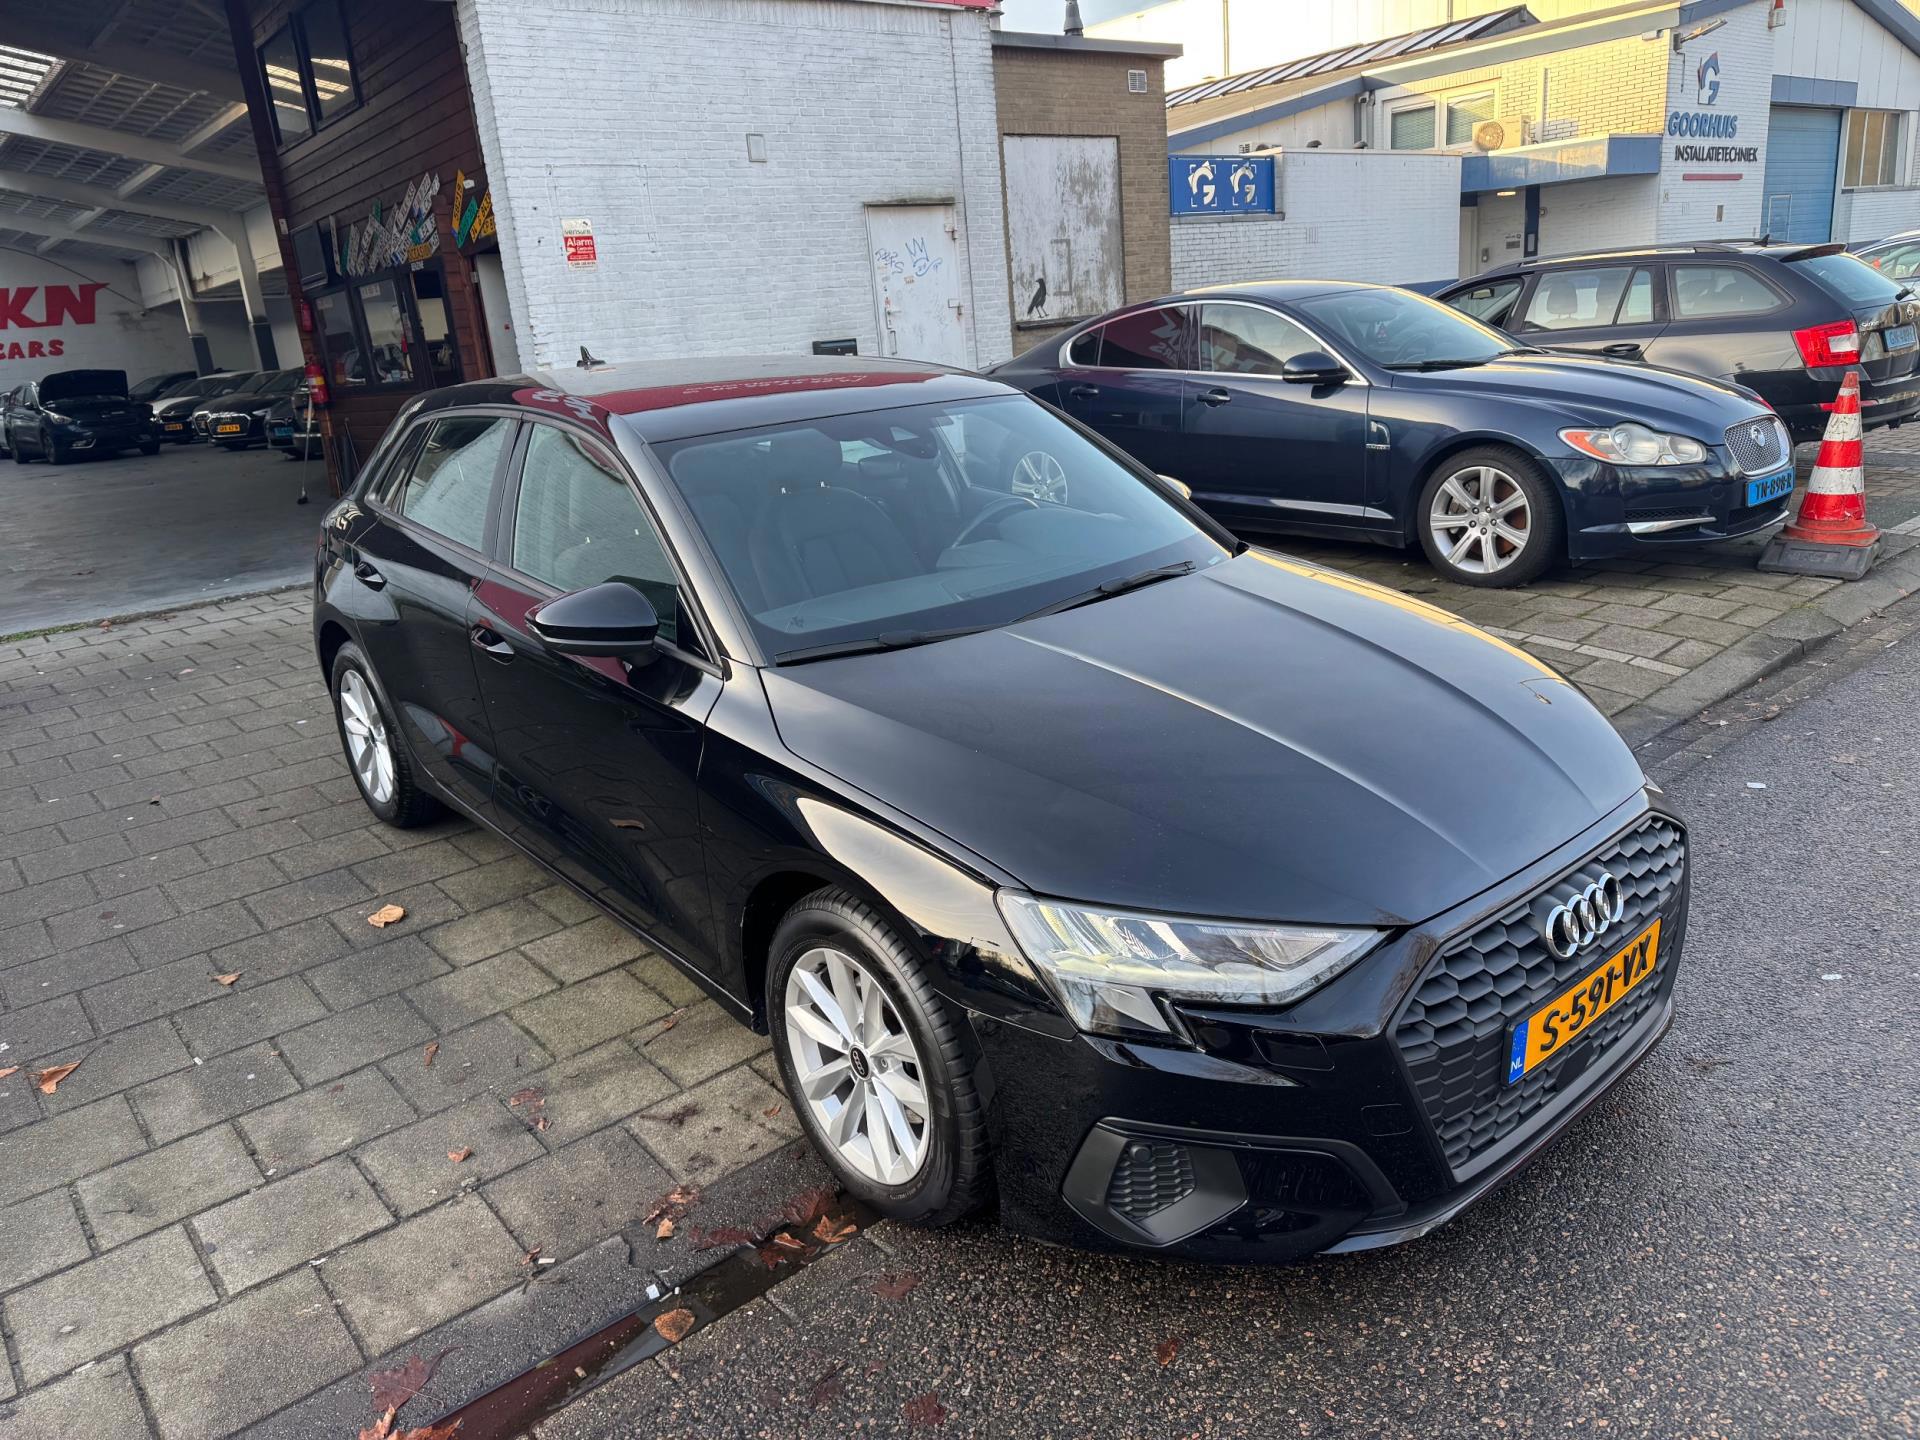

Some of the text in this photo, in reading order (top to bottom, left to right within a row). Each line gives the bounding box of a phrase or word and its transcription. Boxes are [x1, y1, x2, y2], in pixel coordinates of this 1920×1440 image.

[1668, 111, 1738, 138] GOORHUIS
[1675, 145, 1758, 162] INSTALLATIETECHNIEK
[567, 237, 594, 247] Alarm
[1540, 932, 1652, 1052] S-591-VX
[1510, 1057, 1523, 1074] NL
